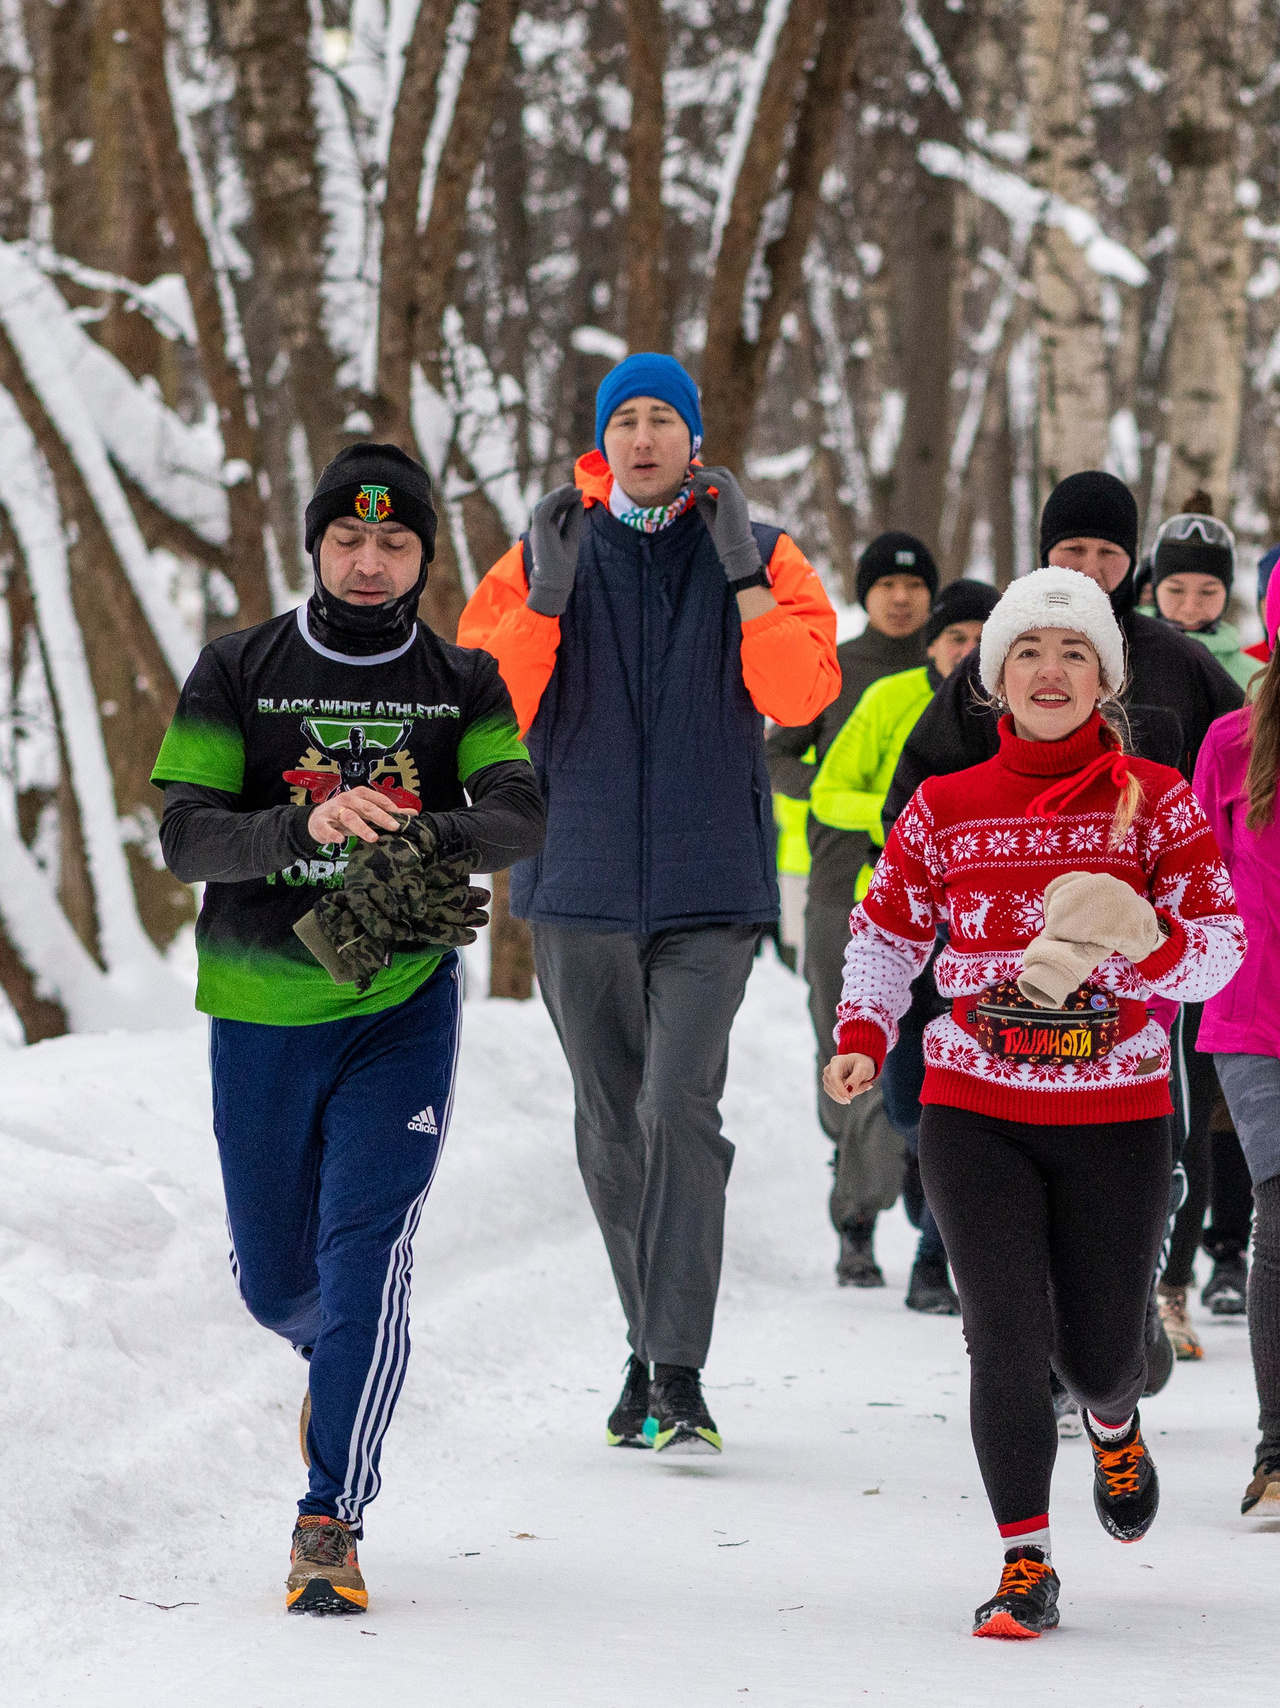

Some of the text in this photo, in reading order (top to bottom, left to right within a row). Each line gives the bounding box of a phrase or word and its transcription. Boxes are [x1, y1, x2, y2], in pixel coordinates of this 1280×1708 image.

[257, 698, 461, 719] BLACK-WHITE ATHLETICS
[407, 1121, 438, 1135] adidas
